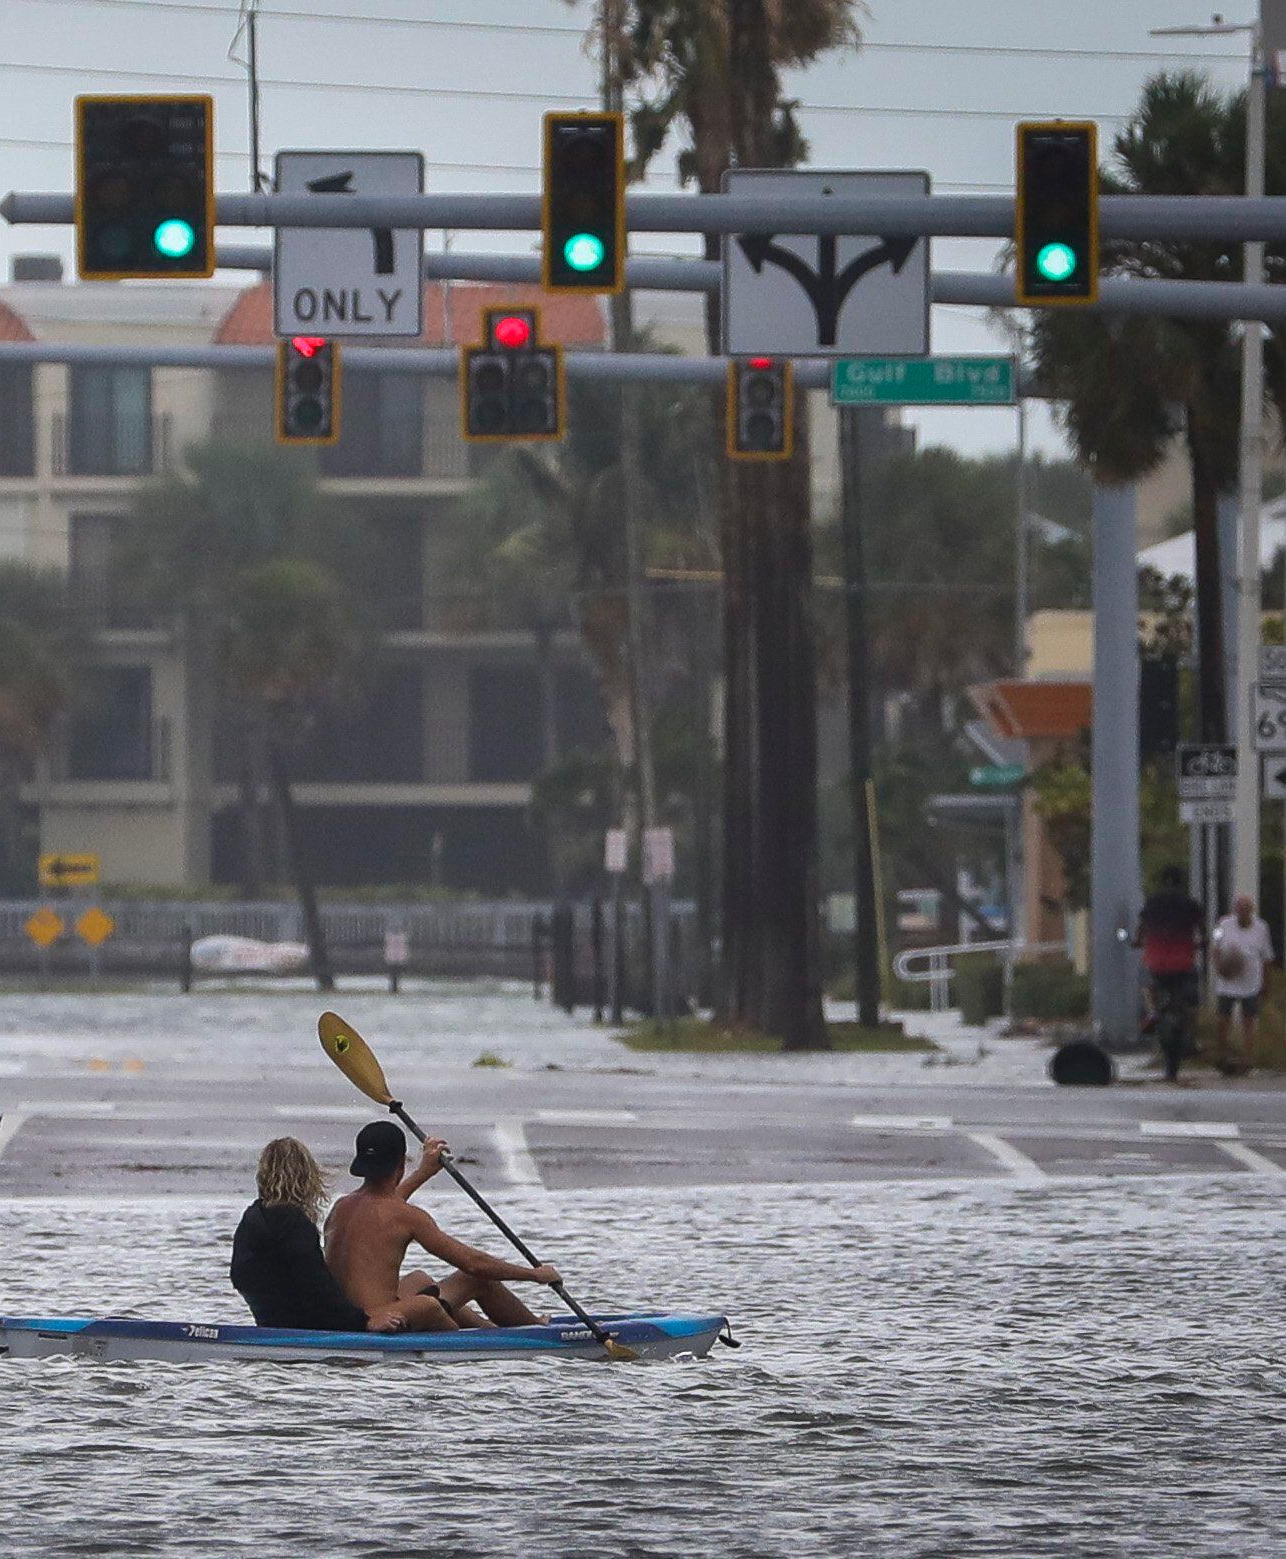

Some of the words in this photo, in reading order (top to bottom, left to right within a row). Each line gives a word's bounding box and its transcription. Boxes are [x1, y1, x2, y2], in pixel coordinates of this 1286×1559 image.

[293, 288, 402, 321] ONLY
[846, 363, 907, 382] Gulf
[933, 363, 1001, 383] Blvd
